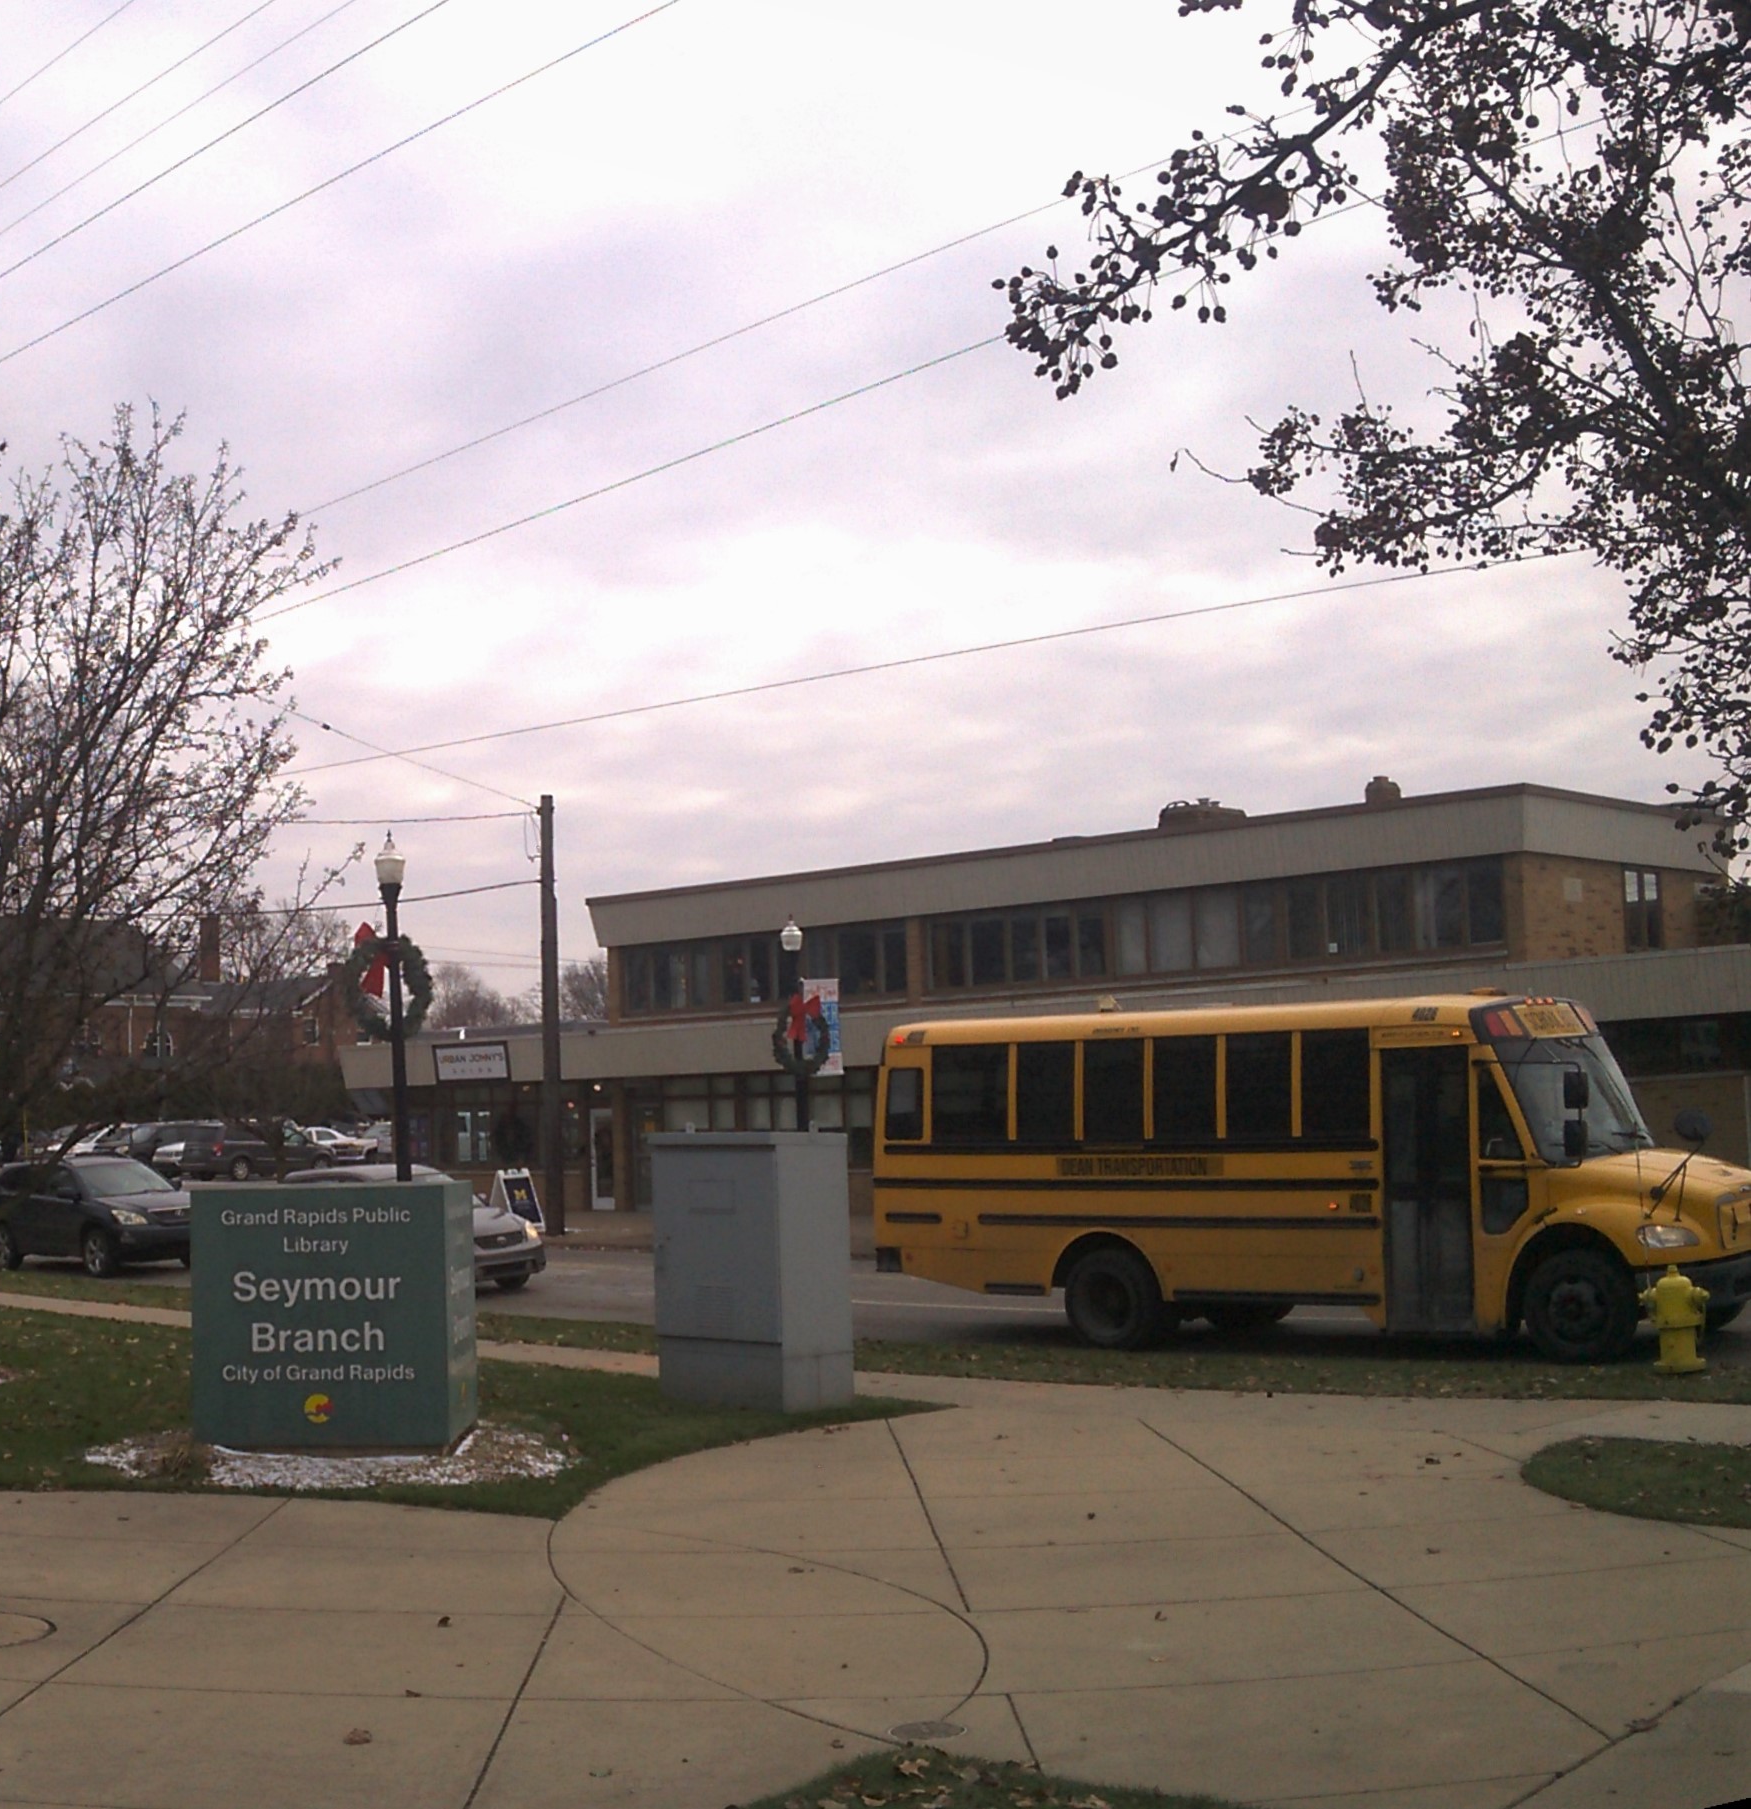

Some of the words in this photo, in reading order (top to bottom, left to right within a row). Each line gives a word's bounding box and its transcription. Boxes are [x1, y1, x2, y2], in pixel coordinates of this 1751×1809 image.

[1097, 1156, 1207, 1176] TRANSPORTATION
[221, 1209, 278, 1225] Grand
[284, 1208, 348, 1227] Rapids
[353, 1207, 411, 1223] Public
[283, 1237, 349, 1255] Library
[233, 1271, 401, 1308] Seymour
[251, 1321, 385, 1352] Branch
[222, 1365, 258, 1384] City
[263, 1365, 282, 1381] of
[286, 1364, 344, 1381] Grand
[350, 1364, 415, 1383] Rapids
